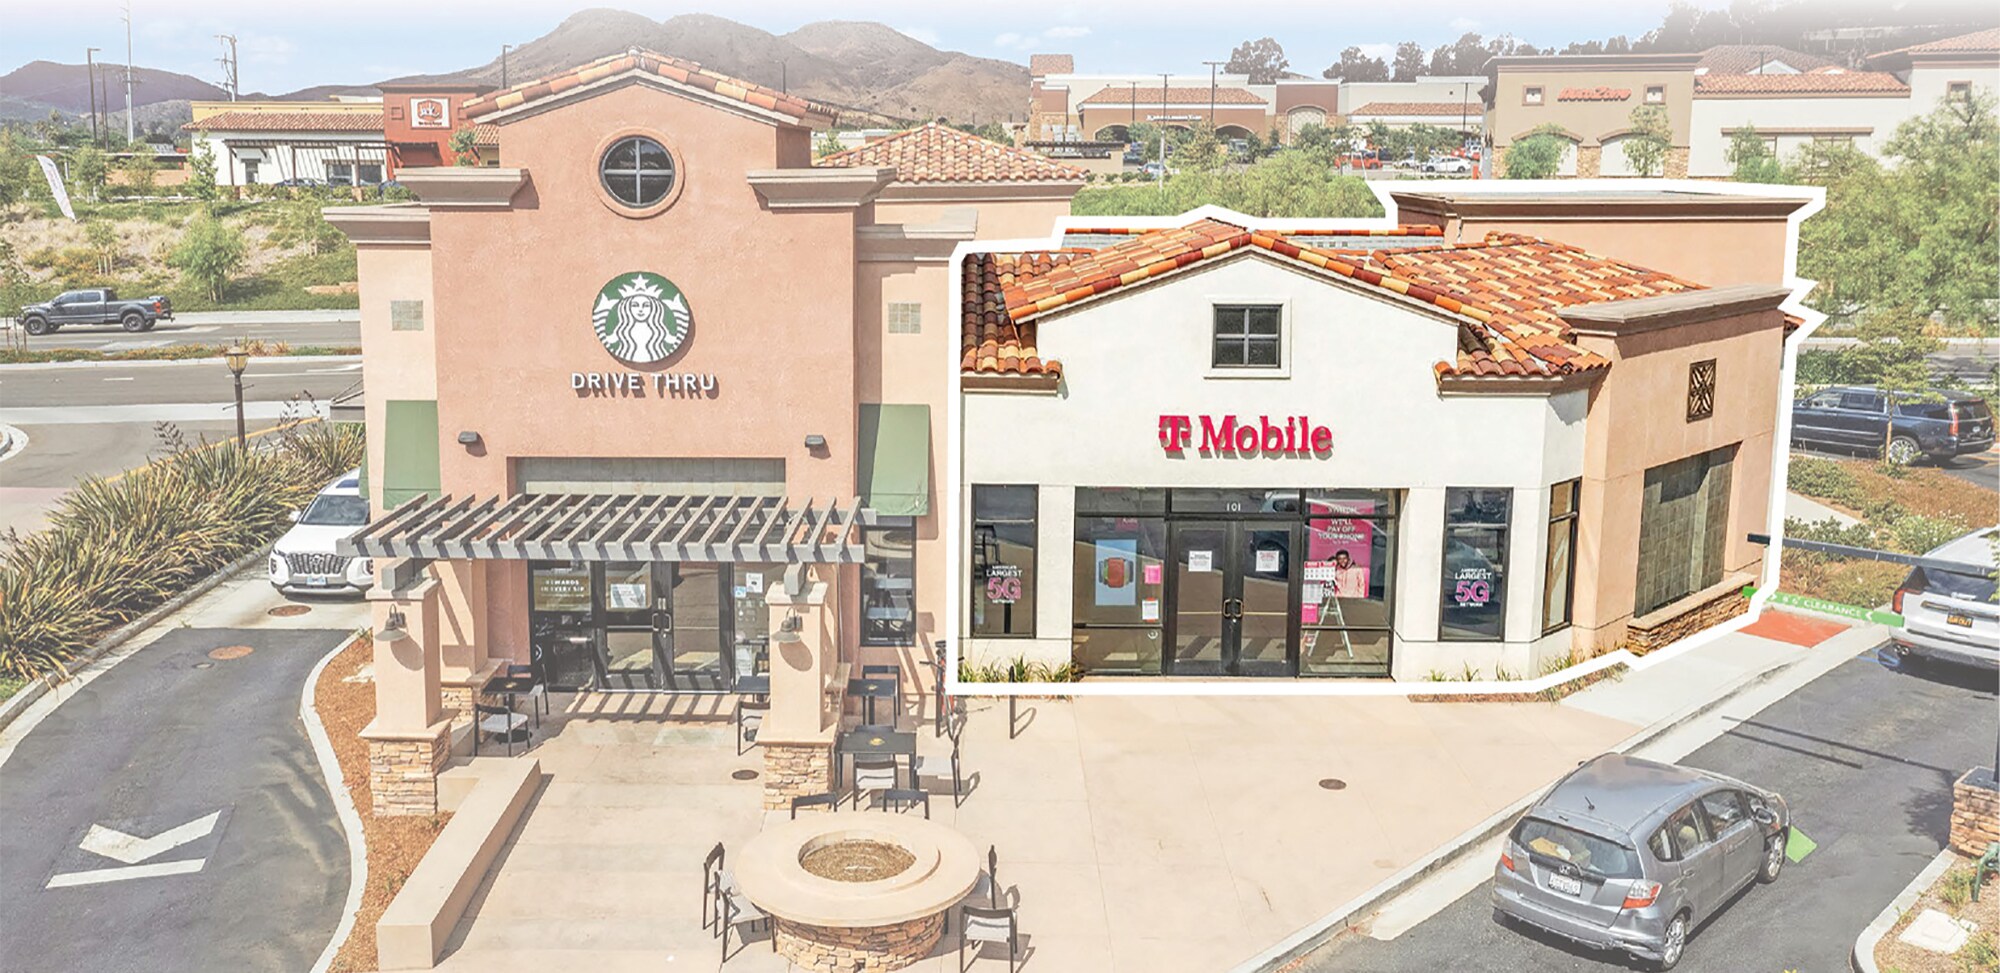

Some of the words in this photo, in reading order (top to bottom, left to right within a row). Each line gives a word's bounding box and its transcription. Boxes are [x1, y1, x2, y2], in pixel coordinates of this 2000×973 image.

[571, 373, 641, 389] DRIVE
[650, 373, 715, 390] THRU
[1198, 415, 1333, 453] Mobile
[1226, 503, 1241, 512] 101
[986, 569, 1022, 577] LARGEST
[1455, 572, 1492, 580] LARGEST
[986, 577, 1022, 600] 5G
[1455, 580, 1490, 603] 5G
[1803, 600, 1862, 617] CLEARANCE
